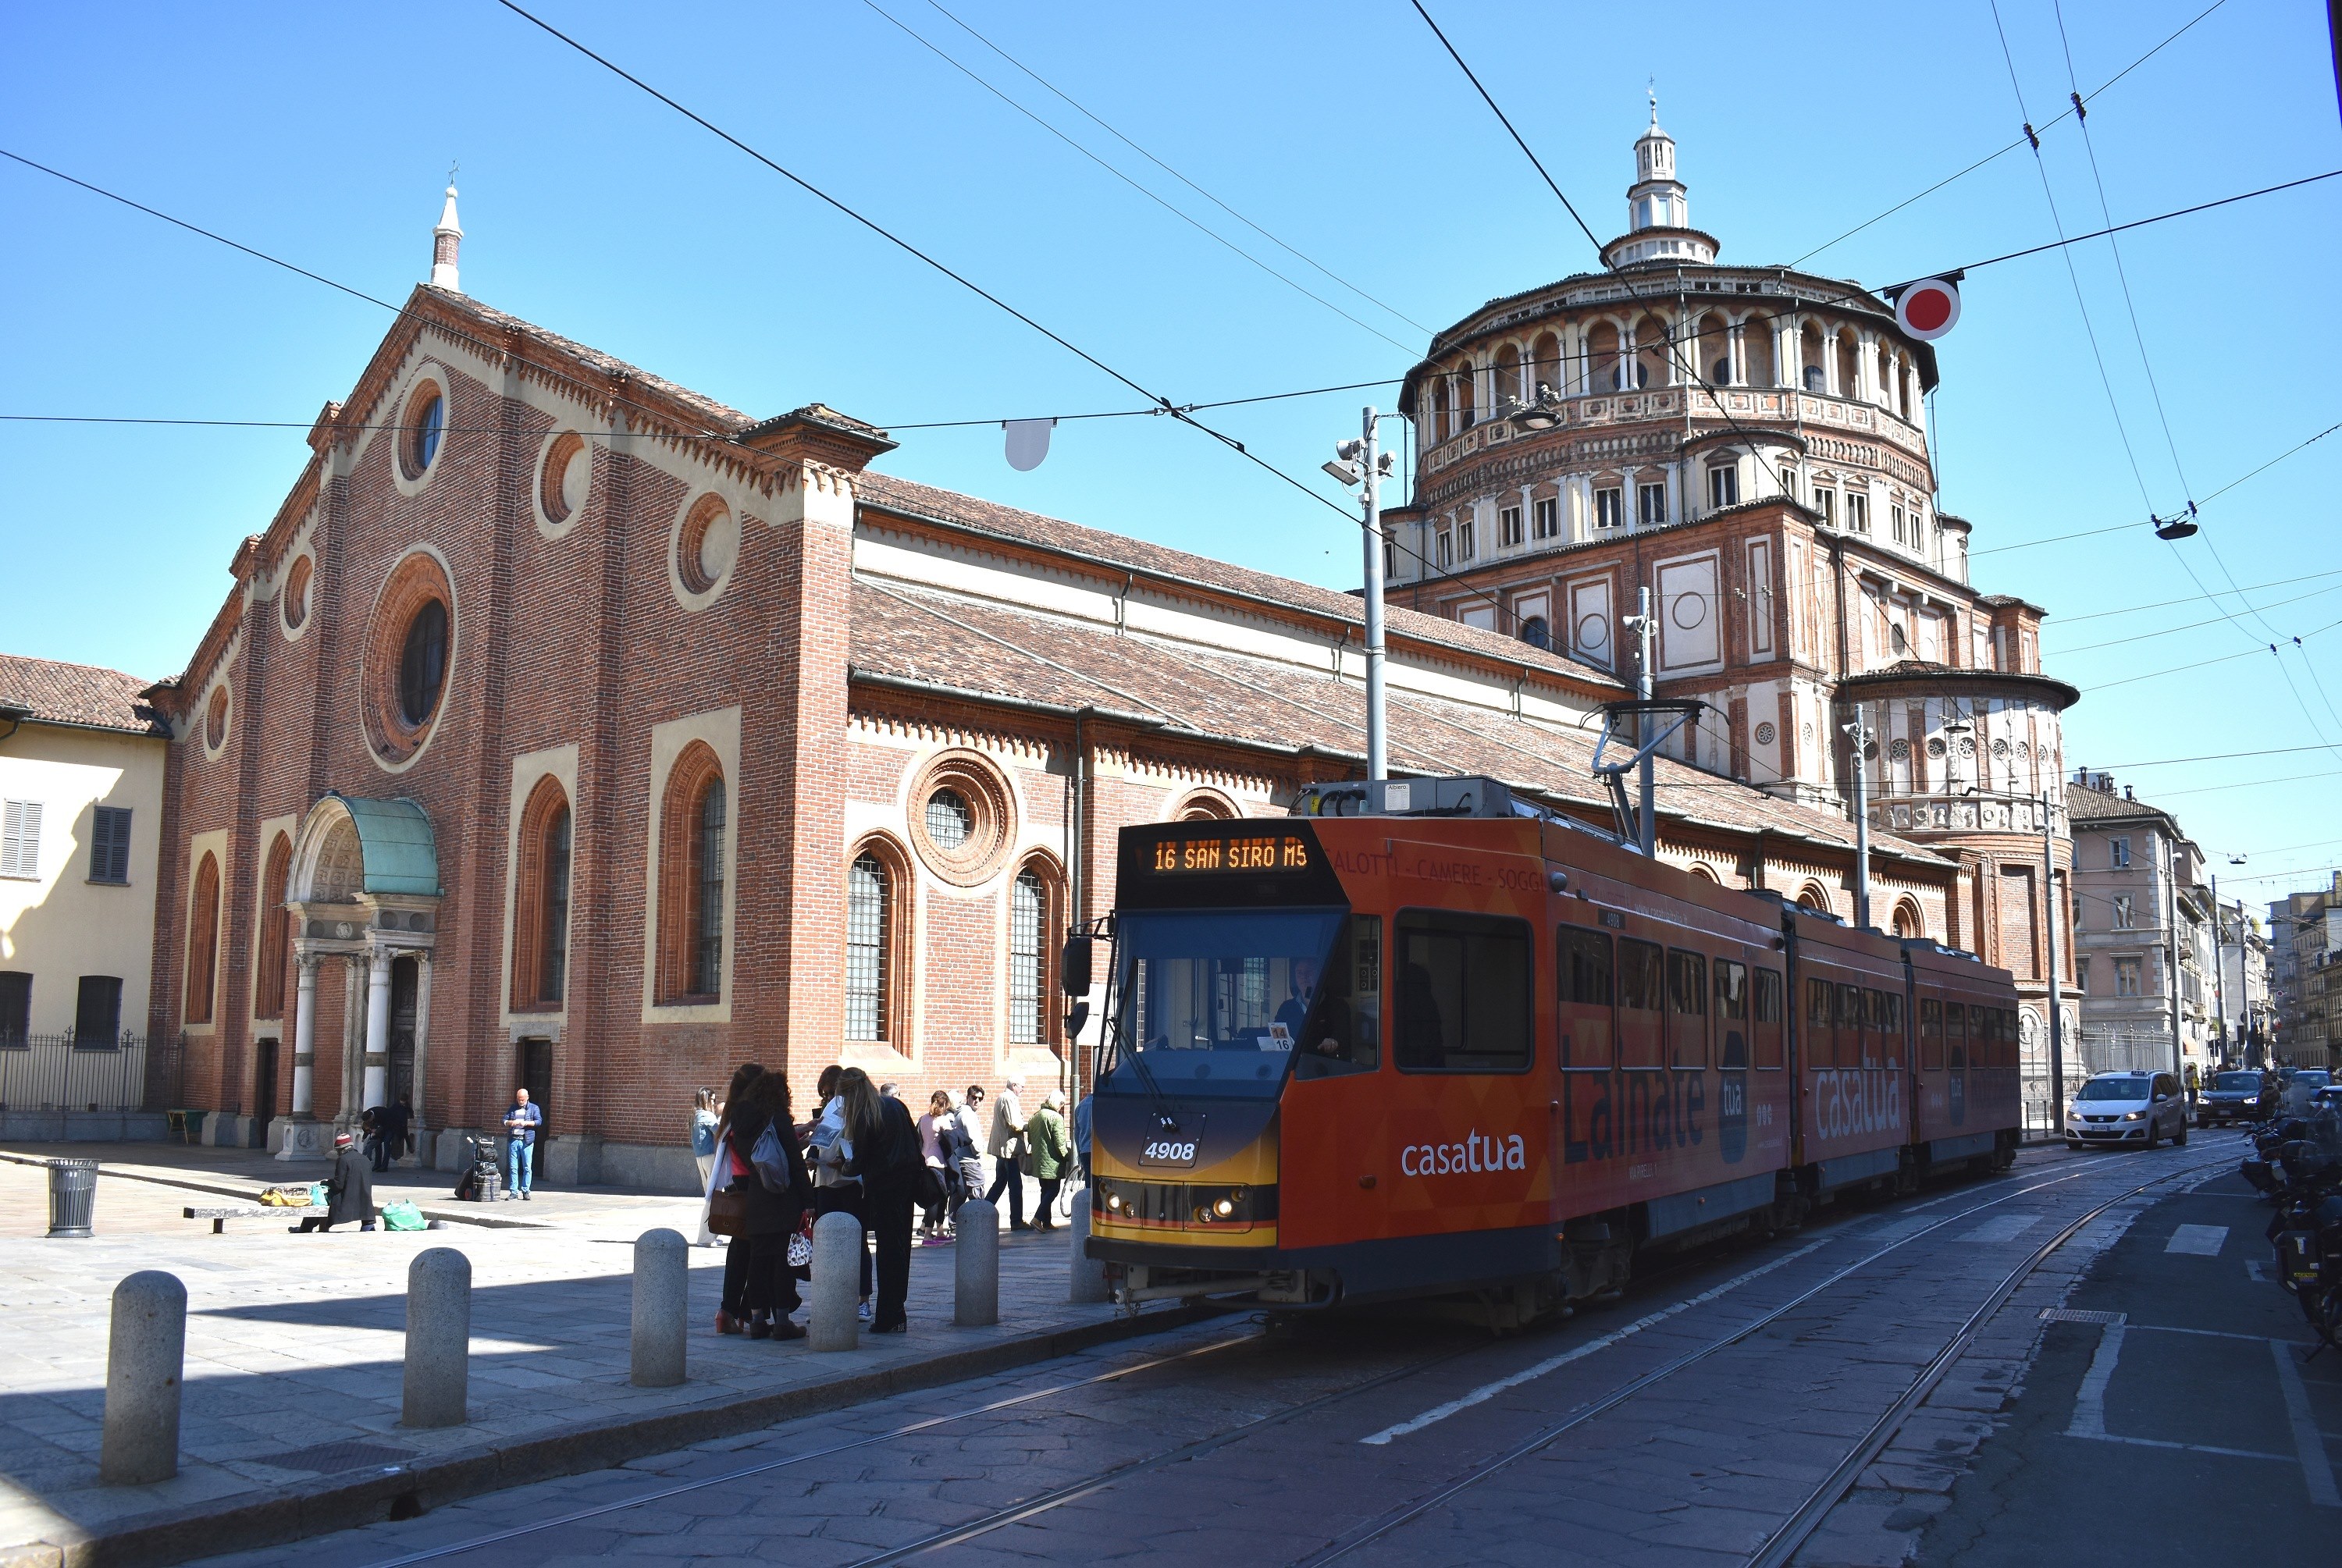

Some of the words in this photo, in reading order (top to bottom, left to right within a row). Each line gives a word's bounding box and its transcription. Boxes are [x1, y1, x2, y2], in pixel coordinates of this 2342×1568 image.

[1155, 848, 1176, 869] 16
[1184, 847, 1220, 869] SAN
[1228, 845, 1275, 868] SIRO
[1283, 844, 1308, 867] M5
[1326, 848, 1399, 878] ALOTTI
[1417, 859, 1482, 887] CAMERE
[1607, 912, 1620, 928] 4908
[1272, 1027, 1287, 1039] 14
[1276, 1040, 1290, 1050] 16
[1562, 1035, 1705, 1164] Lainate
[1724, 1077, 1742, 1116] tua
[1815, 1037, 1900, 1140] casatua
[1144, 1142, 1195, 1161] 4908
[1401, 1127, 1526, 1176] casatua
